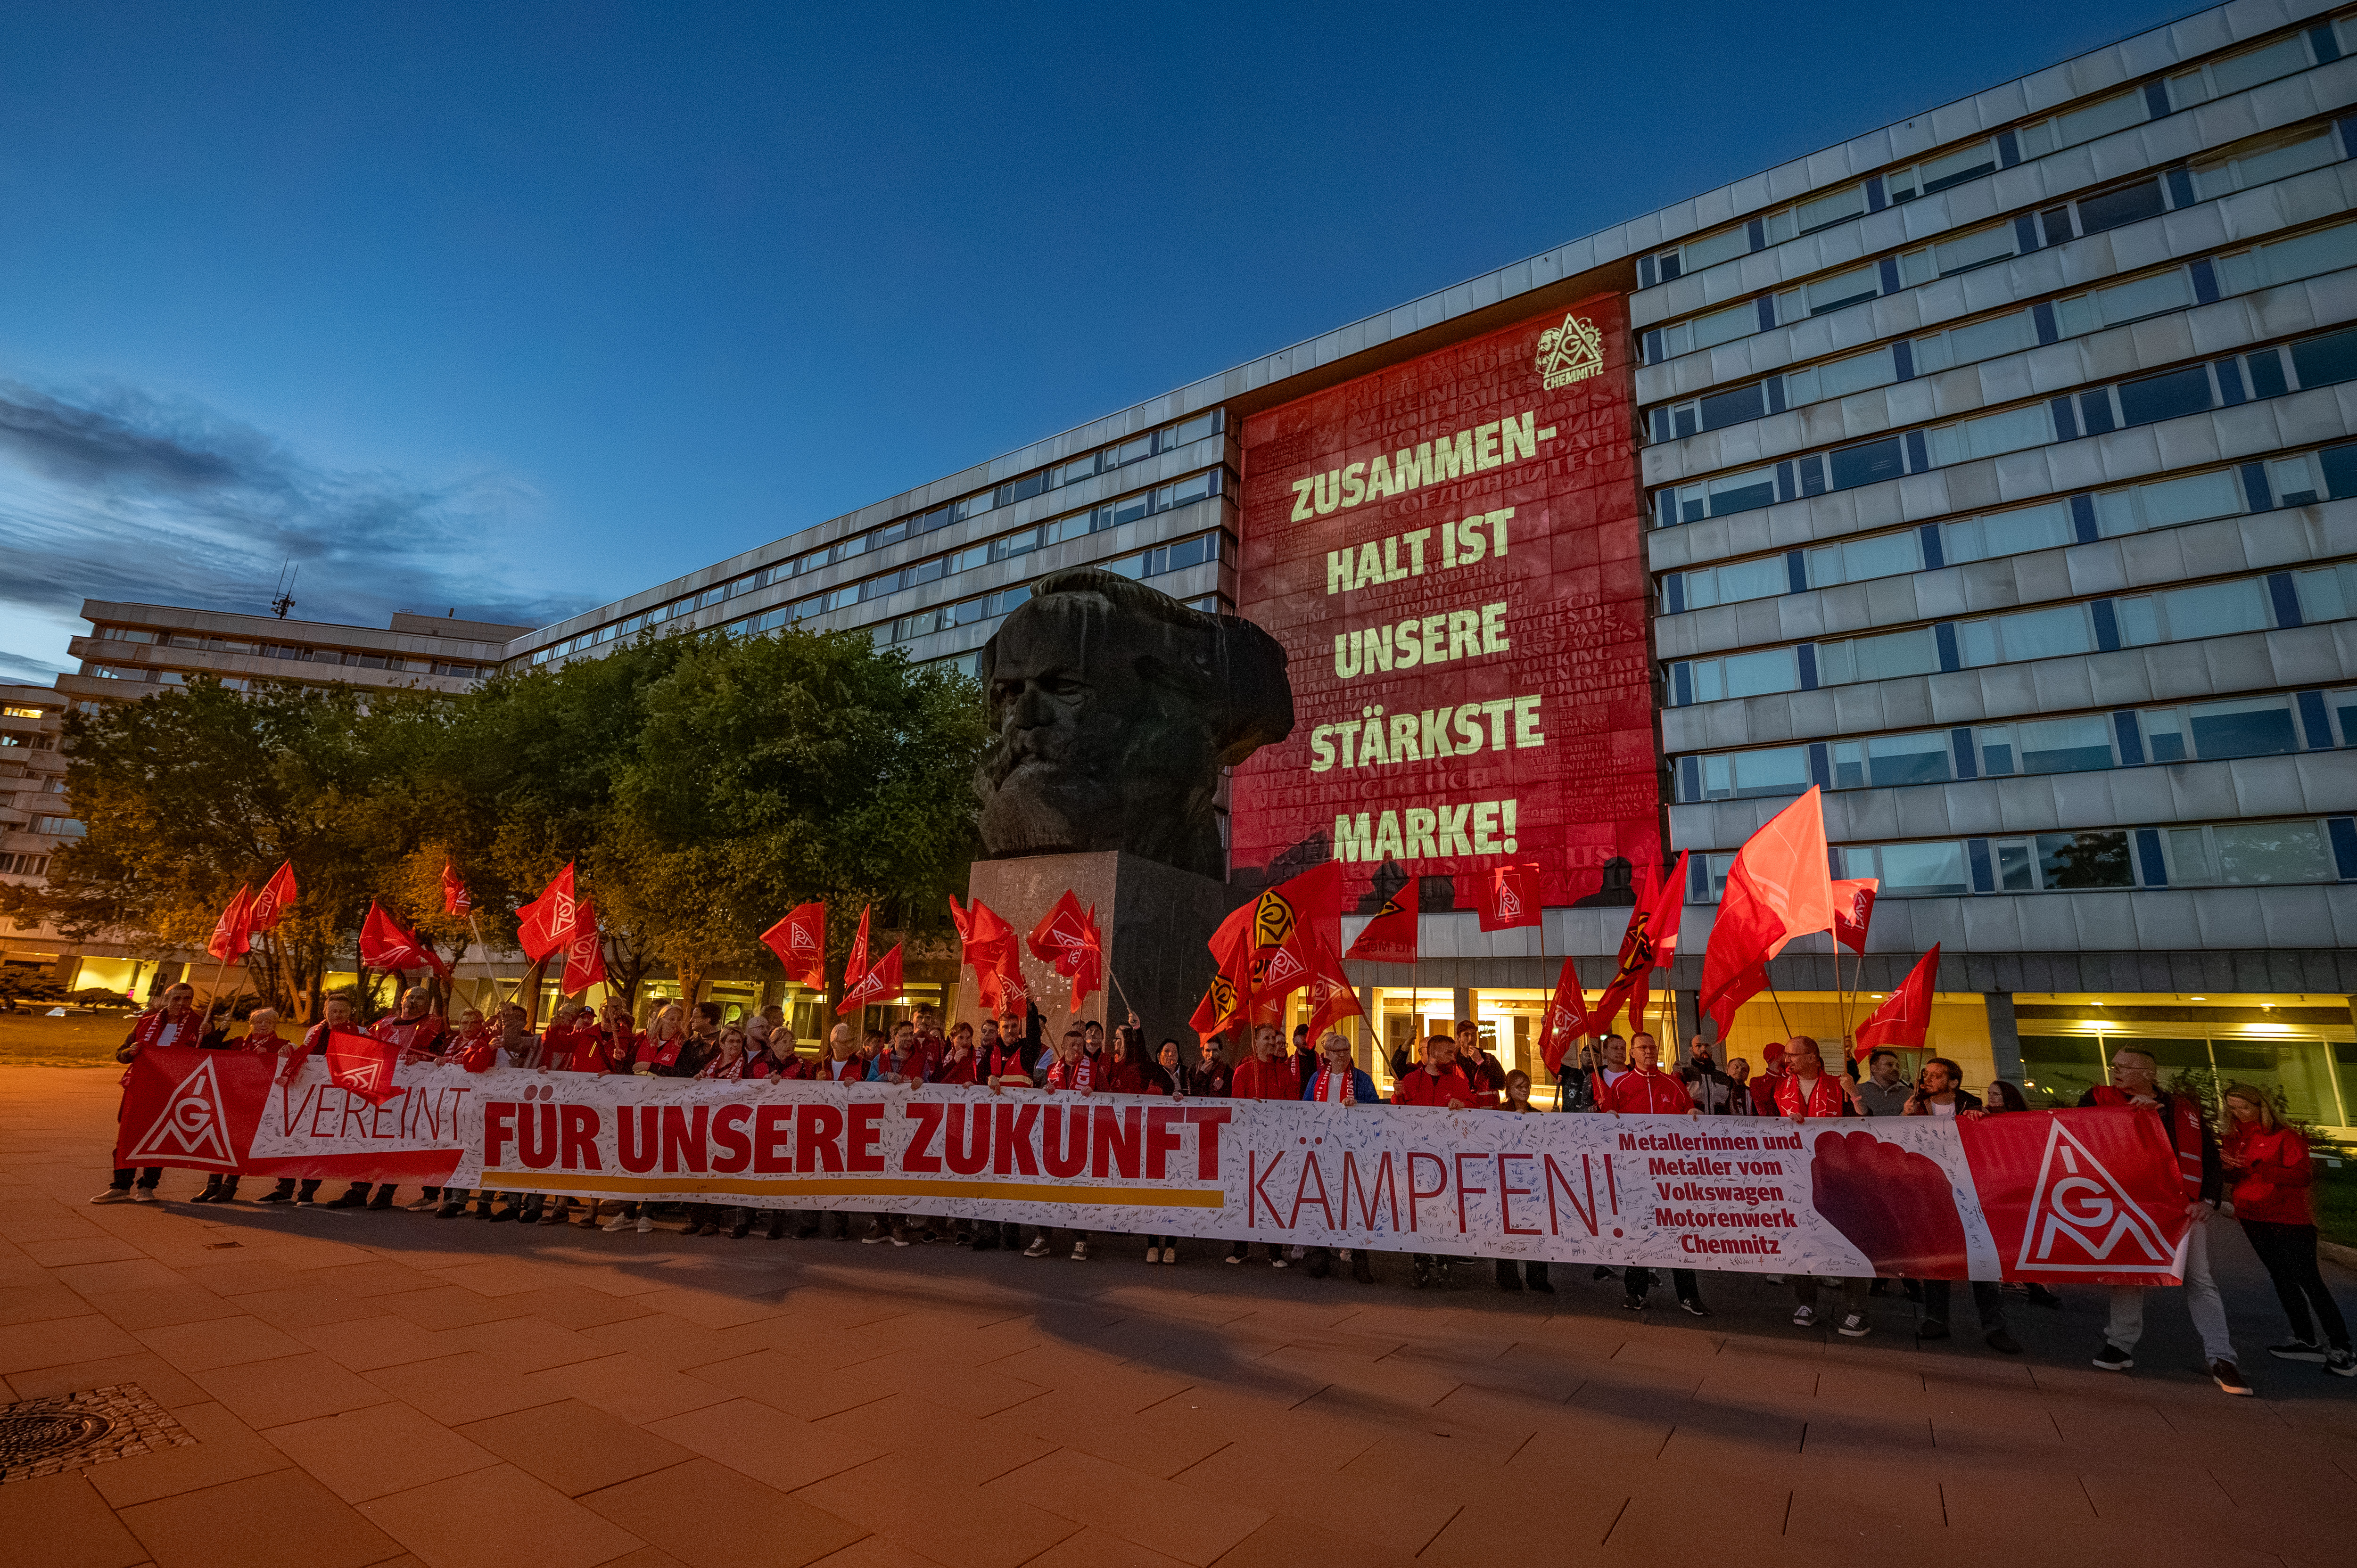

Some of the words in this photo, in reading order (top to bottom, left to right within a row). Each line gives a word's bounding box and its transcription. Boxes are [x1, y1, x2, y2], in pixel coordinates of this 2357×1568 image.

[1543, 361, 1604, 391] CHEMNITZ
[1290, 410, 1557, 523] ZUSAMMEN-
[1327, 526, 1430, 595] HALT
[1442, 507, 1515, 569] IST
[1335, 602, 1510, 679] UNSERE
[1502, 646, 1612, 674] WORKING
[1521, 667, 1570, 686] MEN
[1310, 693, 1545, 772] STÄRKSTE
[1333, 799, 1518, 862] MARKE!
[485, 1084, 602, 1171] FÜR
[617, 1103, 885, 1174] UNSERE
[902, 1103, 1232, 1181] ZUKUNFT
[1619, 1132, 1759, 1151] Metallerinnen
[1763, 1132, 1803, 1150] und
[1648, 1157, 1732, 1175] Metaller
[1740, 1159, 1783, 1175] vom
[1248, 1136, 1624, 1239] KÄMPFEN!
[1656, 1182, 1784, 1206] Volkswagen
[1655, 1207, 1798, 1228] Motorenwerk
[1681, 1234, 1781, 1254] Chemnitz
